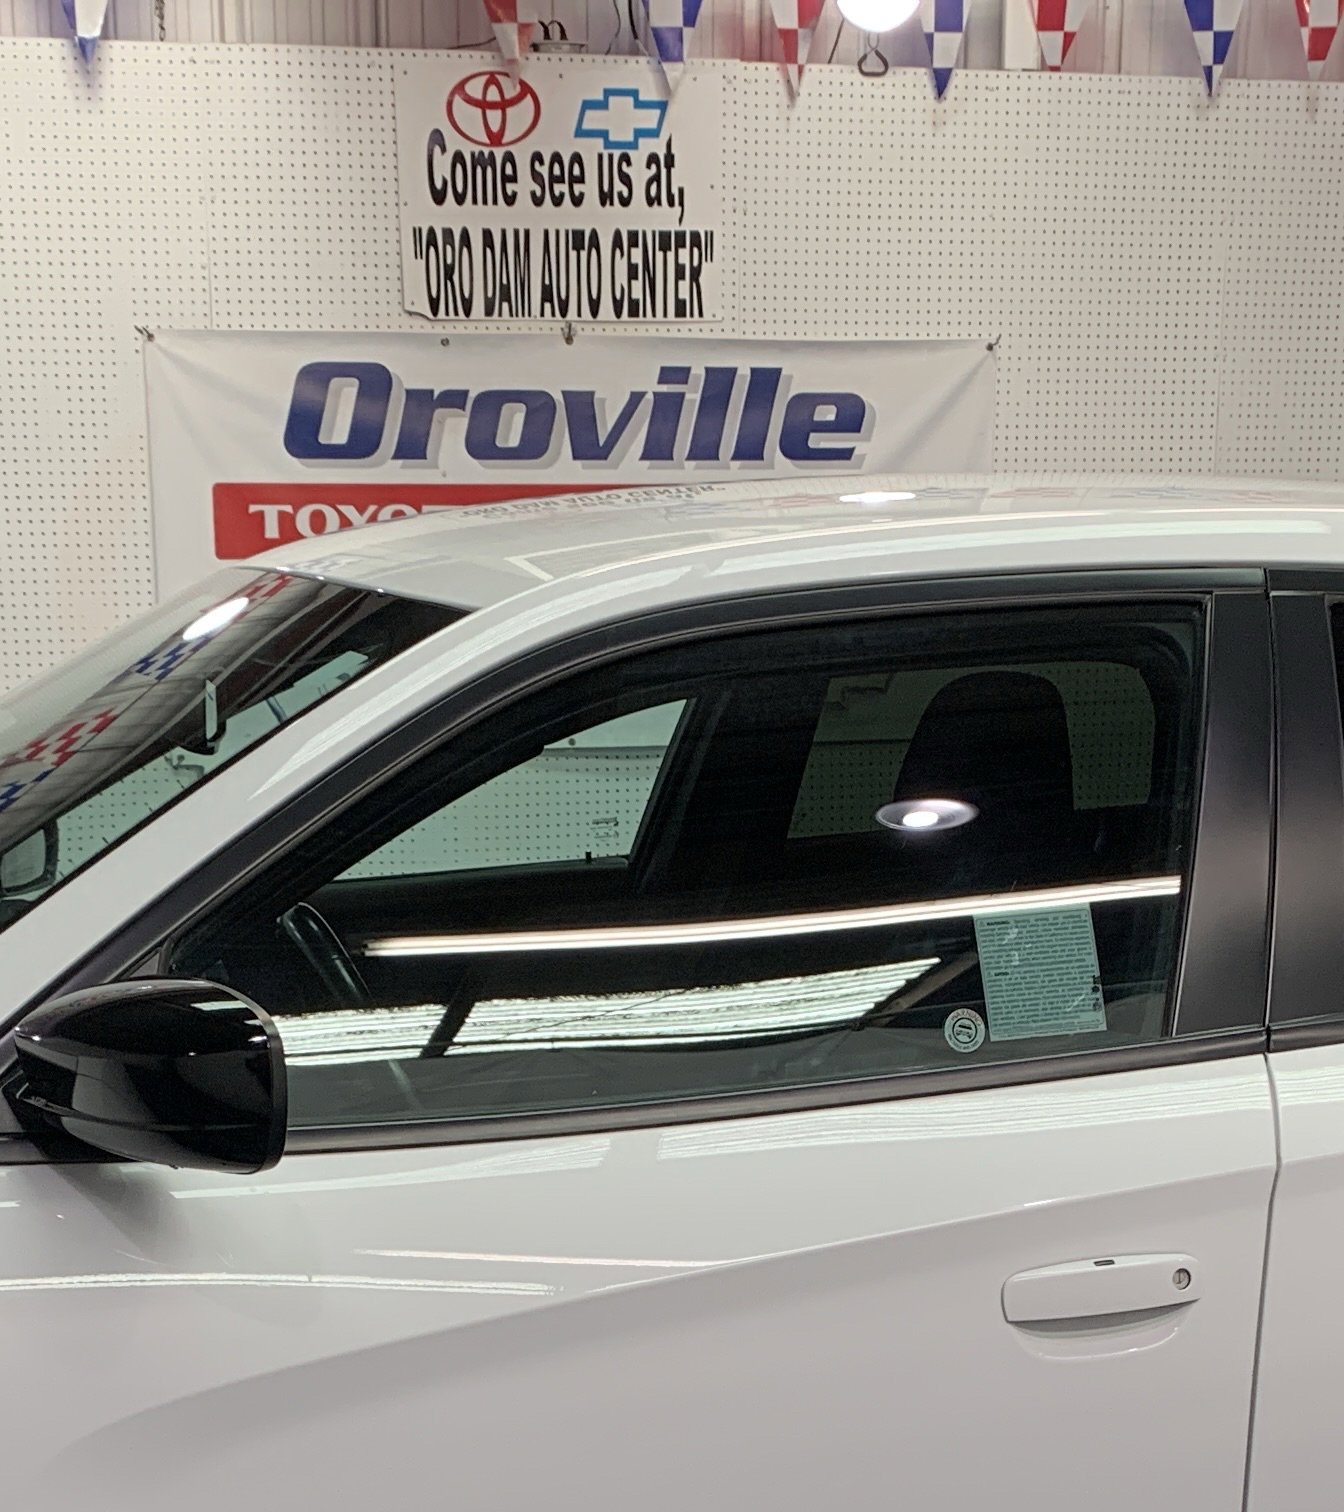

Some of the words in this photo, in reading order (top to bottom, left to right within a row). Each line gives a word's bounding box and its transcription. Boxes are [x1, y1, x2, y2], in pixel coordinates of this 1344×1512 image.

[426, 128, 519, 207] Come
[529, 150, 586, 209] see
[597, 150, 634, 209] us
[644, 132, 686, 226] at,
[412, 224, 475, 320] "ORO
[481, 226, 532, 320] DAM
[540, 227, 603, 320] AUTO
[610, 227, 715, 320] CENTER"
[283, 360, 869, 462] Oroville
[247, 502, 464, 540] TOY
